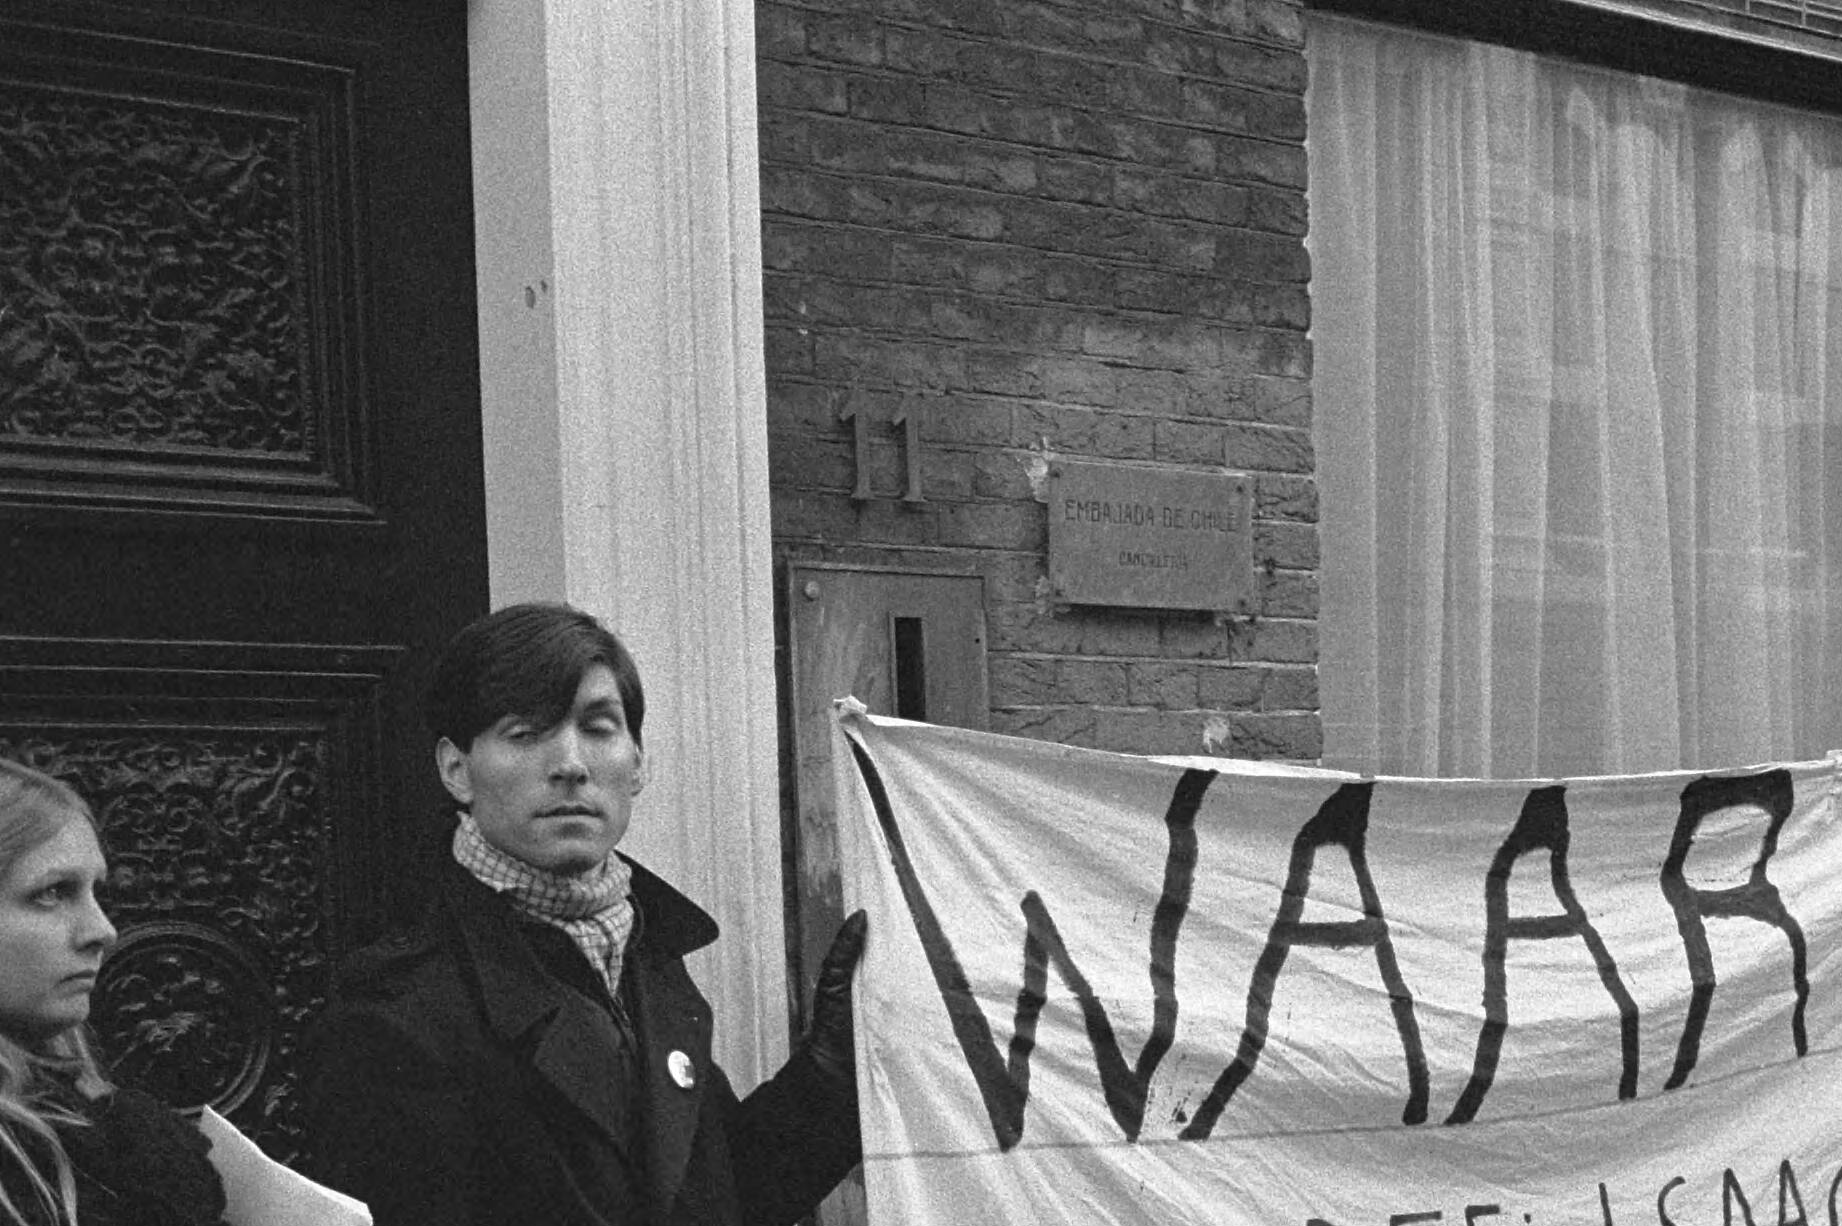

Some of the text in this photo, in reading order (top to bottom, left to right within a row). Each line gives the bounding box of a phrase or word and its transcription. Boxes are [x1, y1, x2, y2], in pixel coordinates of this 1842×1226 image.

[1064, 498, 1238, 533] EMBAJADA DE CHILE
[845, 730, 1808, 1152] WAAR
